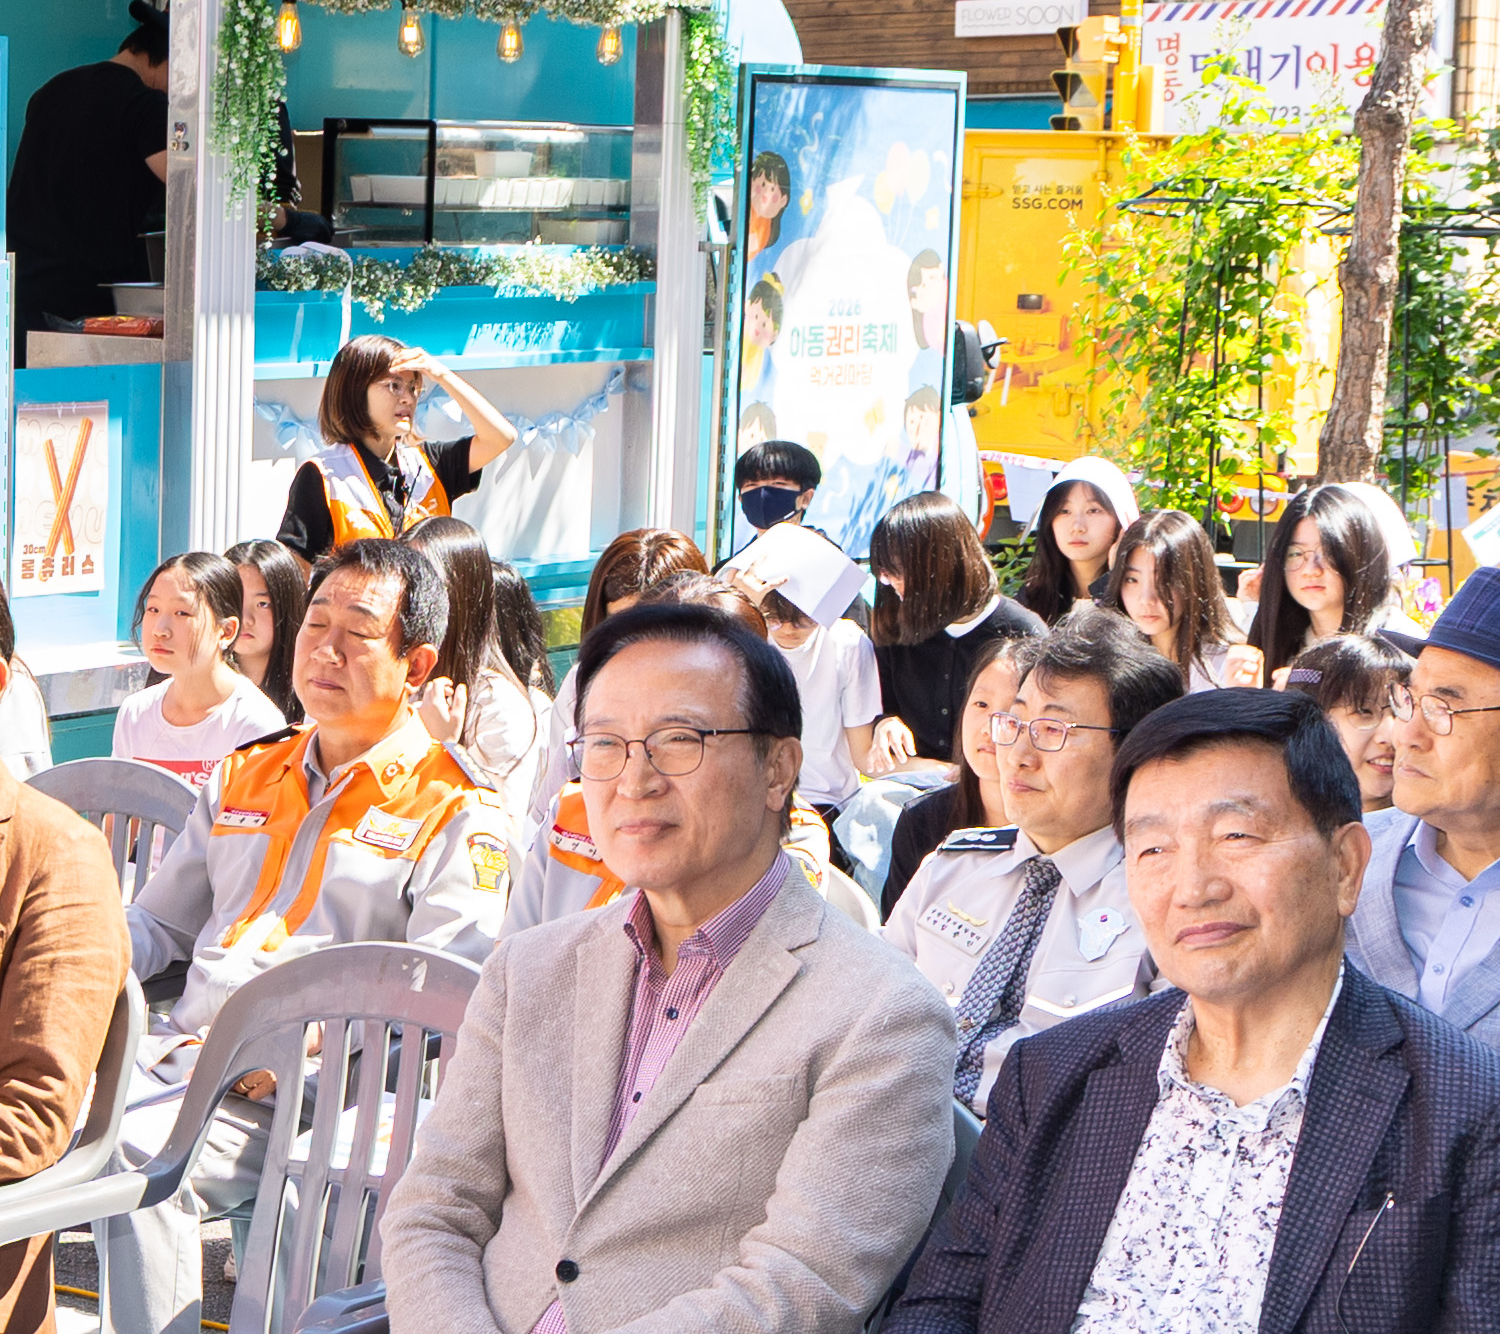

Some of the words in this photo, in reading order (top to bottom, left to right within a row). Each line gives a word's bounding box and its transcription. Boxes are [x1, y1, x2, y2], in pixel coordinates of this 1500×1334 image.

[961, 7, 1012, 25] FLOWER
[1015, 3, 1076, 27] SOON
[1012, 197, 1083, 210] SSG.COM
[828, 298, 861, 317] 2026
[790, 323, 898, 357] 아동권리축제
[23, 544, 47, 555] 30cm
